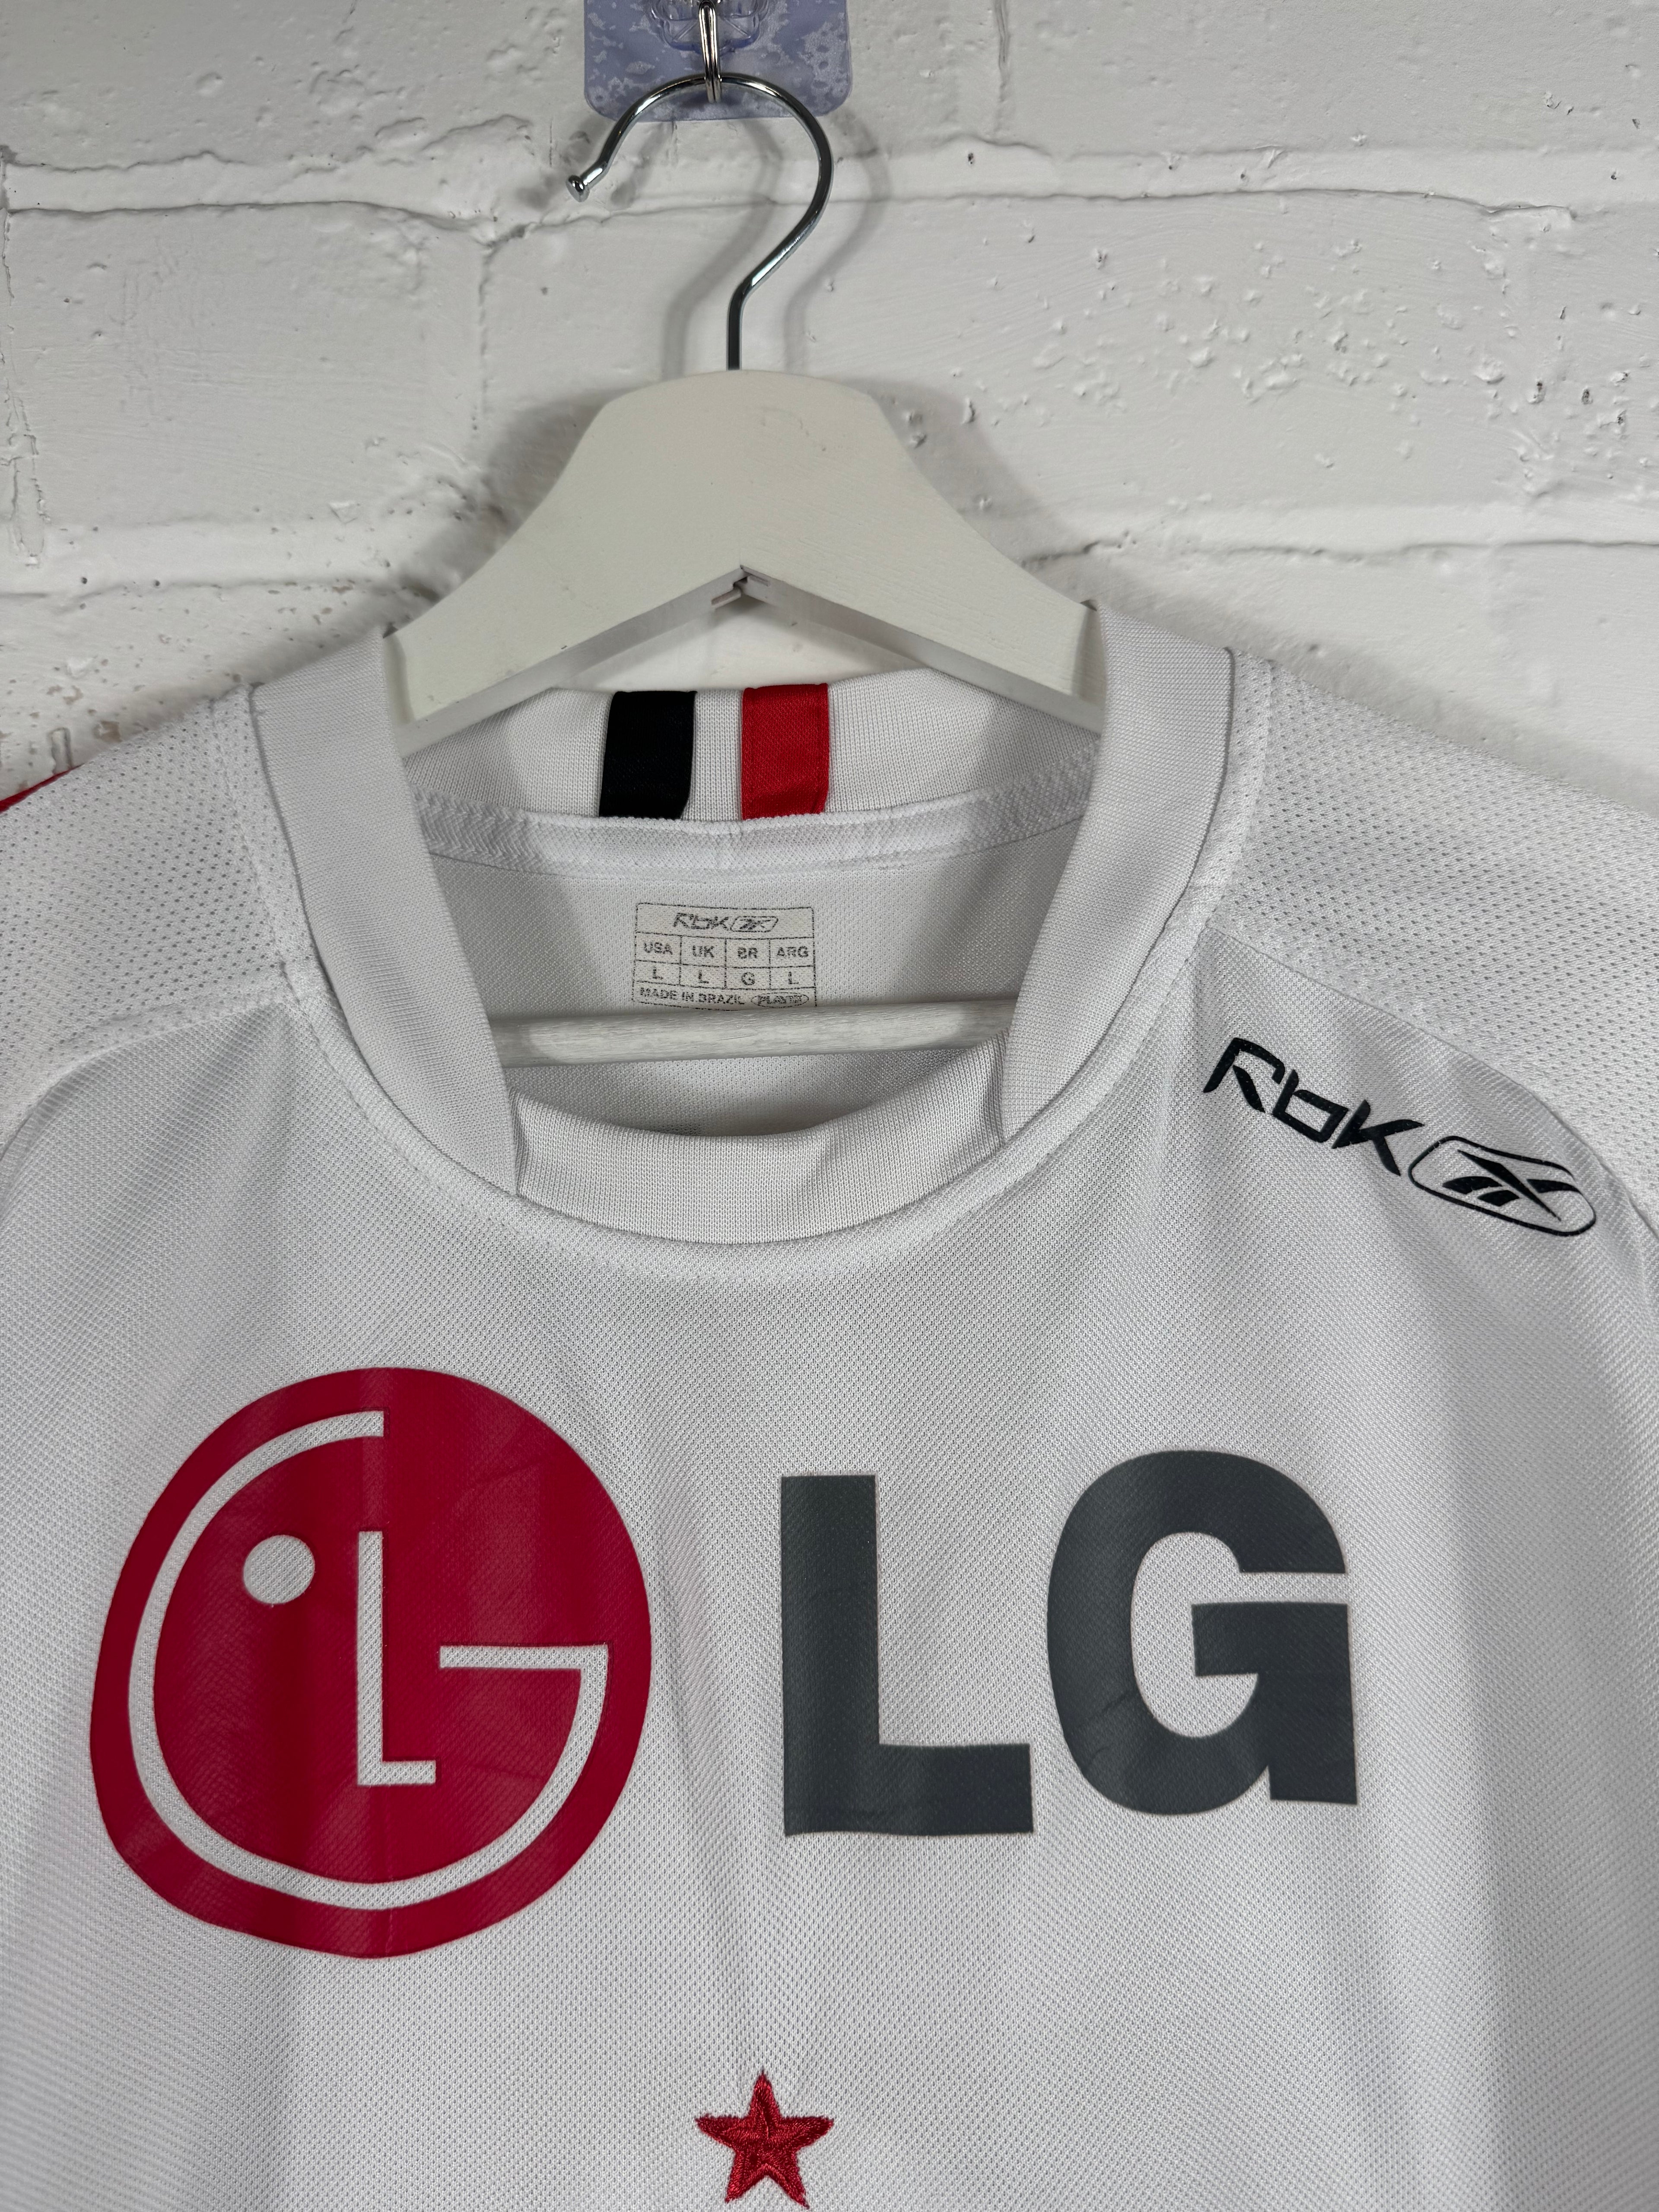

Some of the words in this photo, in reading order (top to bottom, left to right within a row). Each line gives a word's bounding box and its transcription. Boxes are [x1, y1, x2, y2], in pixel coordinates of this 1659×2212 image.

[644, 942, 673, 955] USA
[693, 945, 715, 958] UK
[738, 947, 758, 959] BR
[777, 946, 808, 958] ARG
[652, 966, 663, 980] L
[698, 969, 709, 984] L
[741, 972, 756, 985] G
[788, 971, 799, 985] L
[640, 988, 678, 1000] MADE
[682, 992, 694, 1002] IN
[699, 993, 745, 1004] BRAZIL
[780, 1449, 1357, 1837] LG
